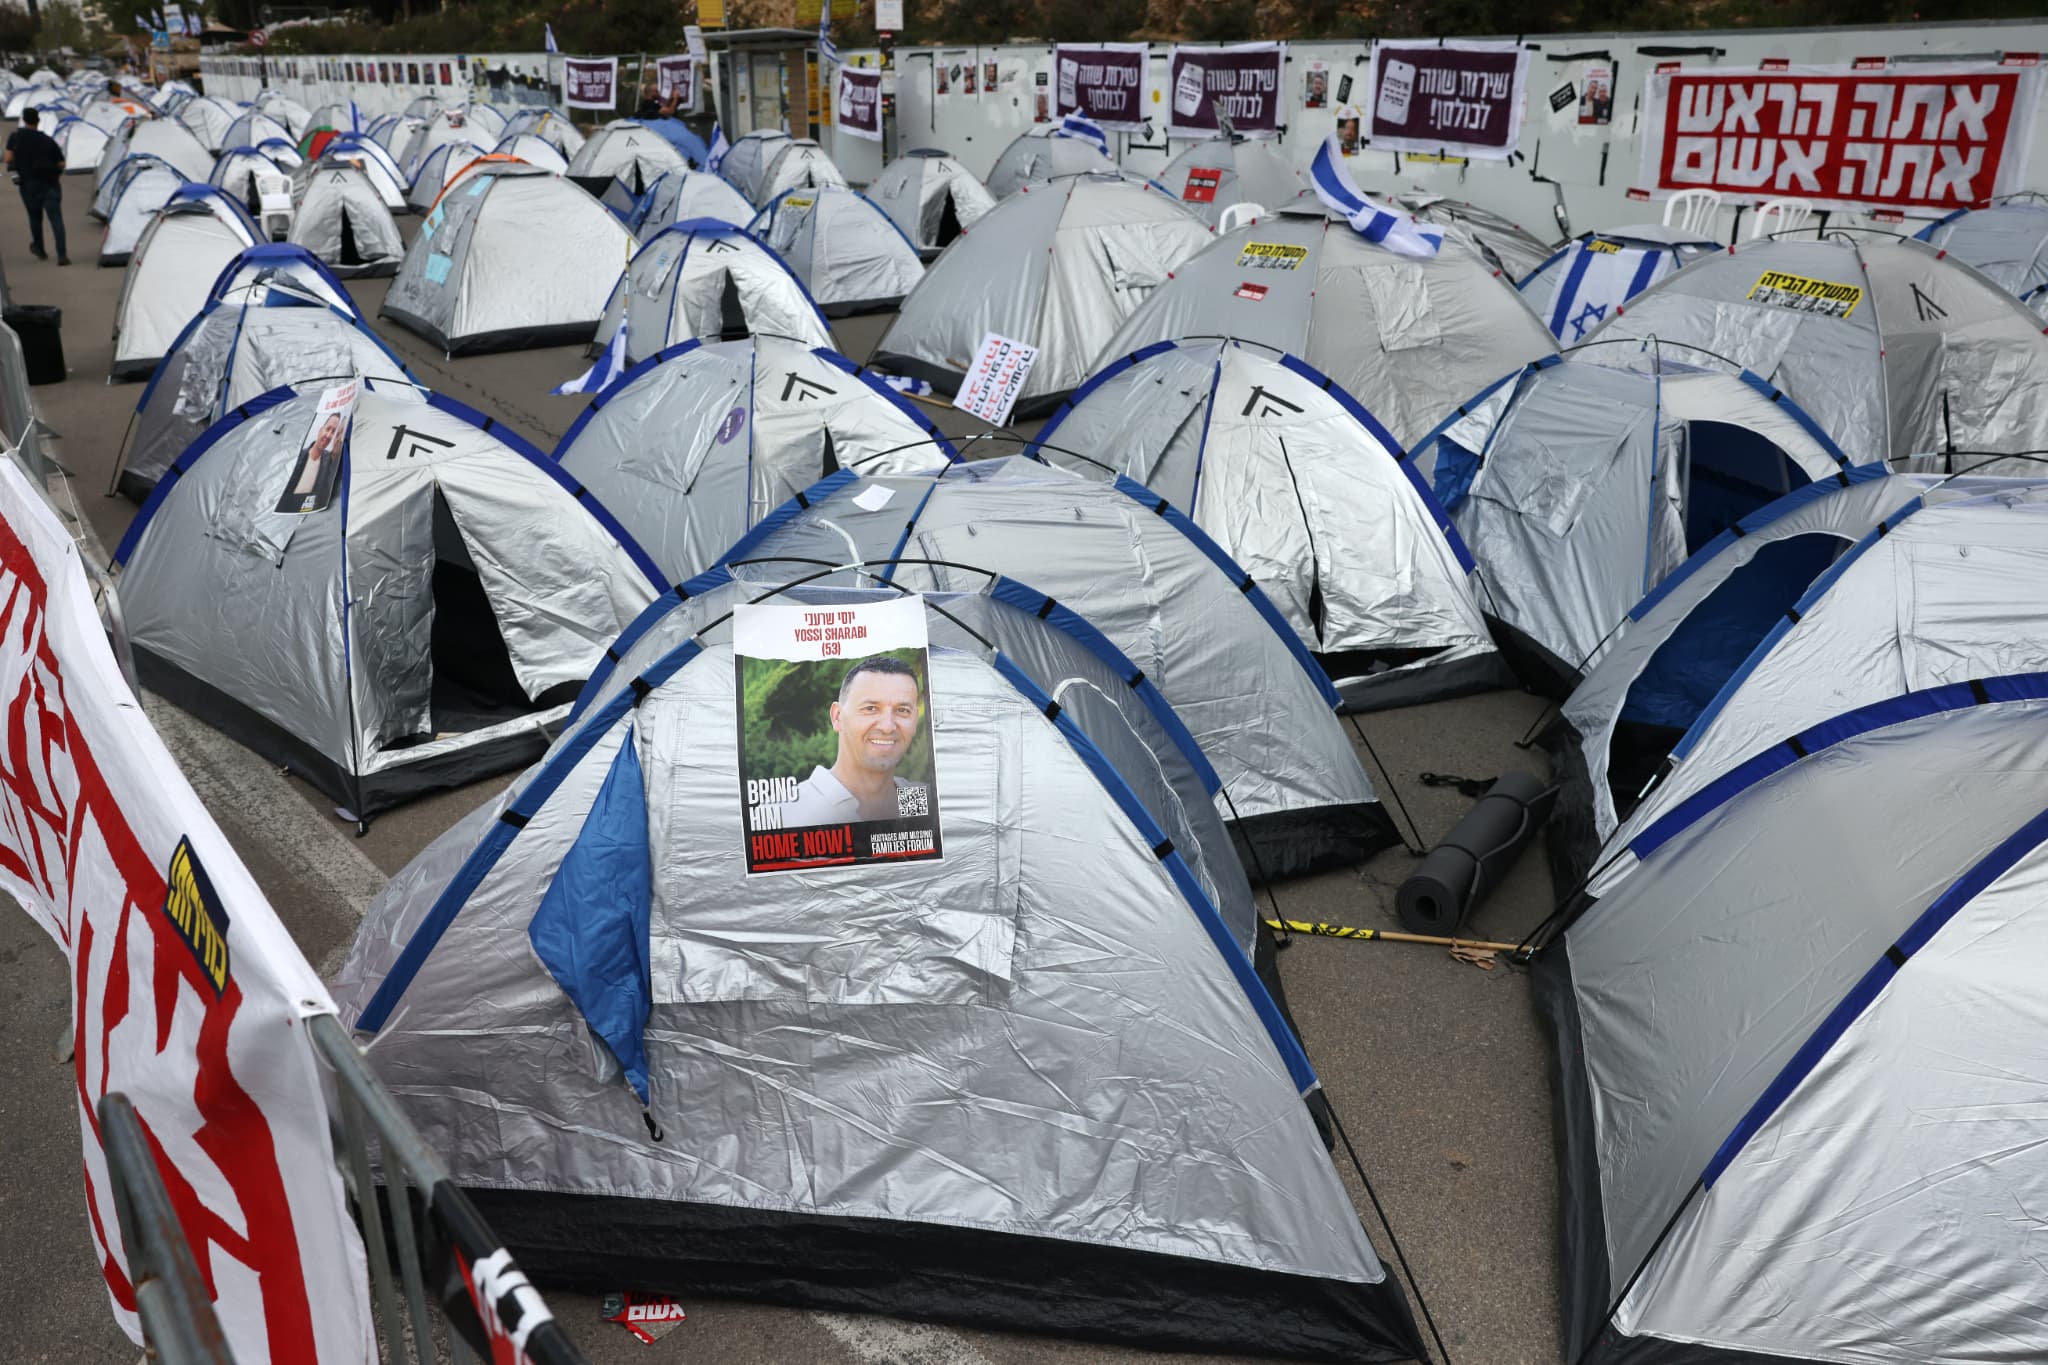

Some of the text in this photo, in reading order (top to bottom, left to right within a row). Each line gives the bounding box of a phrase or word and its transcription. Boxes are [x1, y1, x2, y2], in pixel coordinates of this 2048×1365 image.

[1206, 69, 1236, 91] שווה
[1239, 69, 1276, 92] שירות
[1418, 68, 1457, 95] שווה
[1460, 70, 1510, 100] שירות
[1677, 82, 2000, 141] אתה הראש
[1670, 136, 1986, 203] אתה אשם
[1760, 272, 1860, 302] ממשלת הביזה
[964, 339, 1002, 410] הביתה!
[973, 342, 1011, 414] החטופים
[982, 348, 1022, 420] הביתה!
[992, 349, 1034, 424] הממשלה
[804, 611, 856, 626] יוסי שרעבי
[794, 626, 867, 642] YOSSI SHARABI
[822, 641, 841, 656] (53)
[747, 776, 798, 804] BRING
[749, 804, 782, 832] HIM
[752, 825, 853, 861] HOME NOW!
[870, 832, 898, 842] HOSTAGES
[898, 831, 908, 840] AND
[872, 838, 934, 854] FAMILIES FORUM
